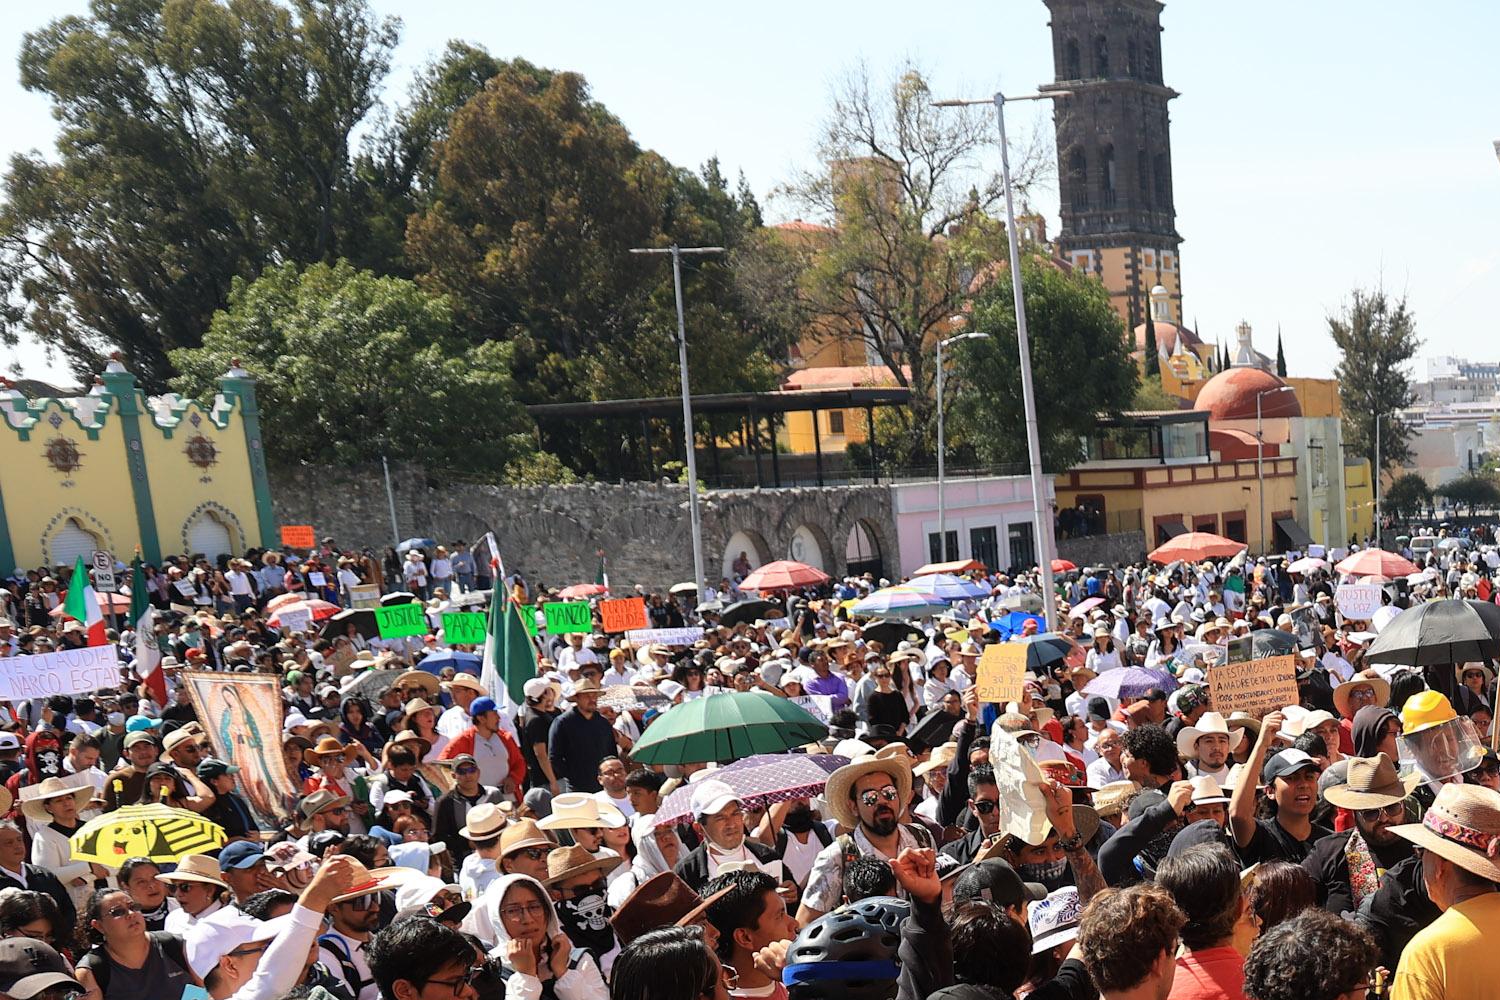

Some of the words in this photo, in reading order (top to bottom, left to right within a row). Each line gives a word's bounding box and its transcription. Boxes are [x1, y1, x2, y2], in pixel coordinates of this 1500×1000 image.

[98, 573, 111, 581] NO
[442, 614, 487, 639] PARA
[545, 604, 589, 626] MANZO
[606, 613, 645, 629] CLAUDIA
[8, 672, 61, 698] NARCO
